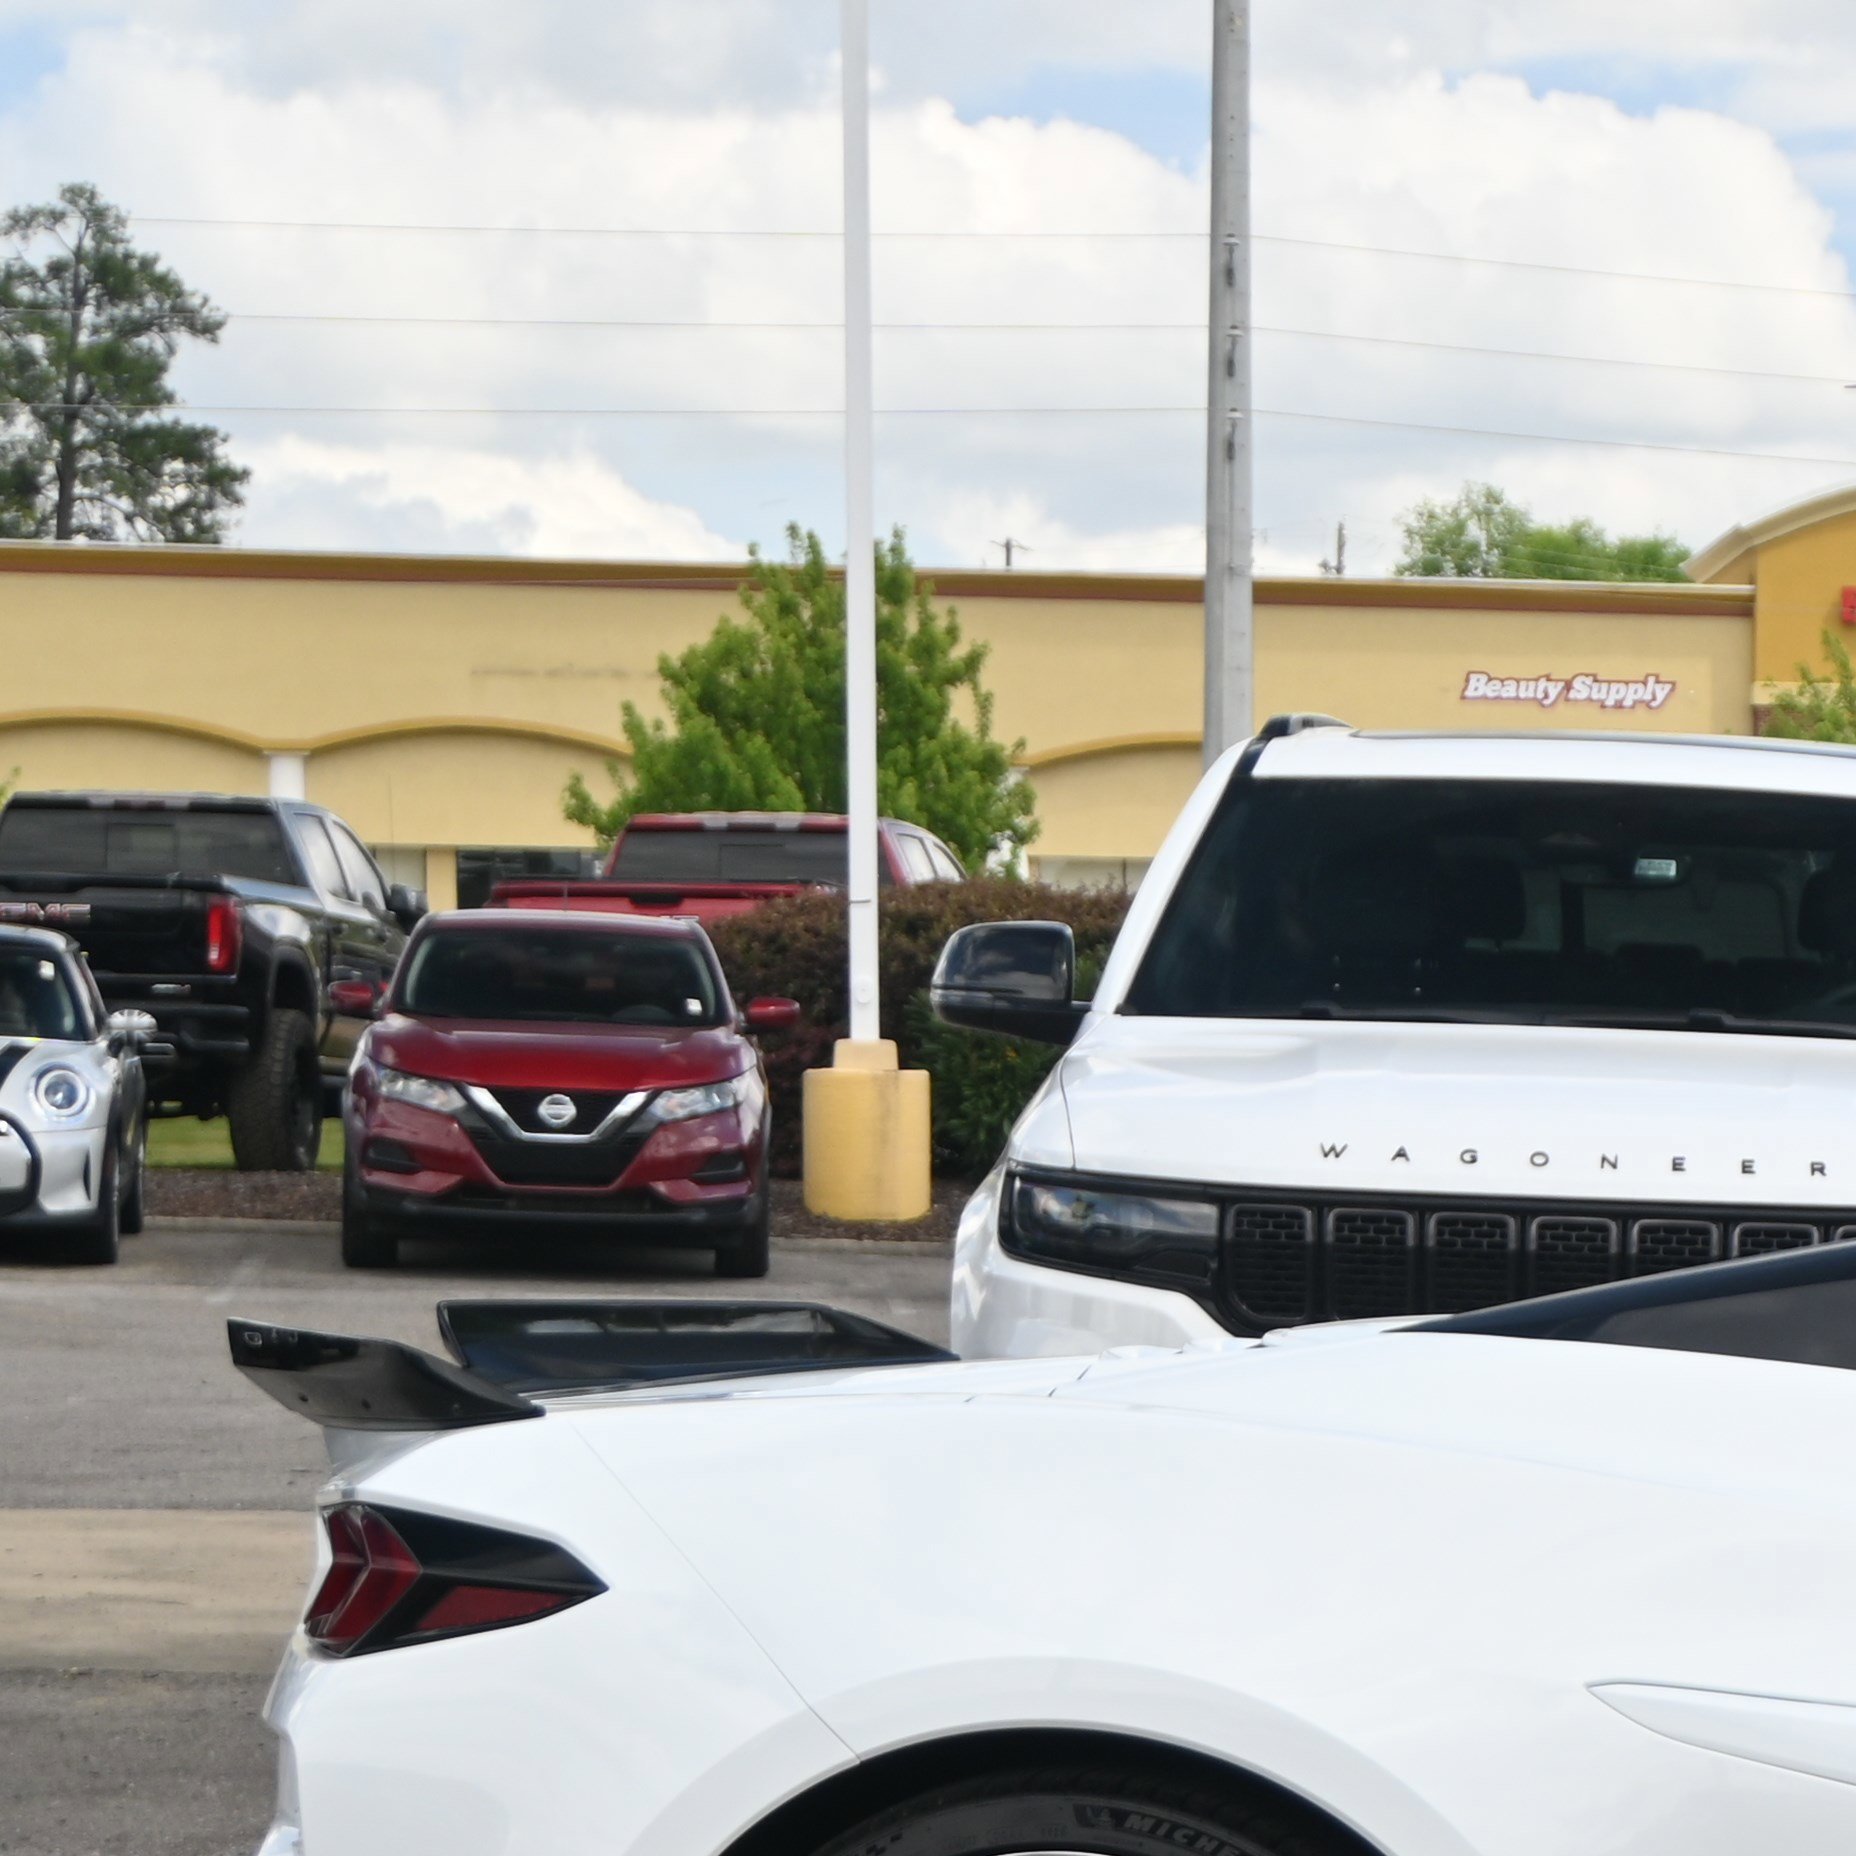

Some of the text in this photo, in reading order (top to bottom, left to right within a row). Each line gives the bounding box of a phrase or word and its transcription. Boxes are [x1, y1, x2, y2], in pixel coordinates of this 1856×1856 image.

[1464, 673, 1673, 708] Beauty Supply
[1320, 1142, 1827, 1177] WAGONEER
